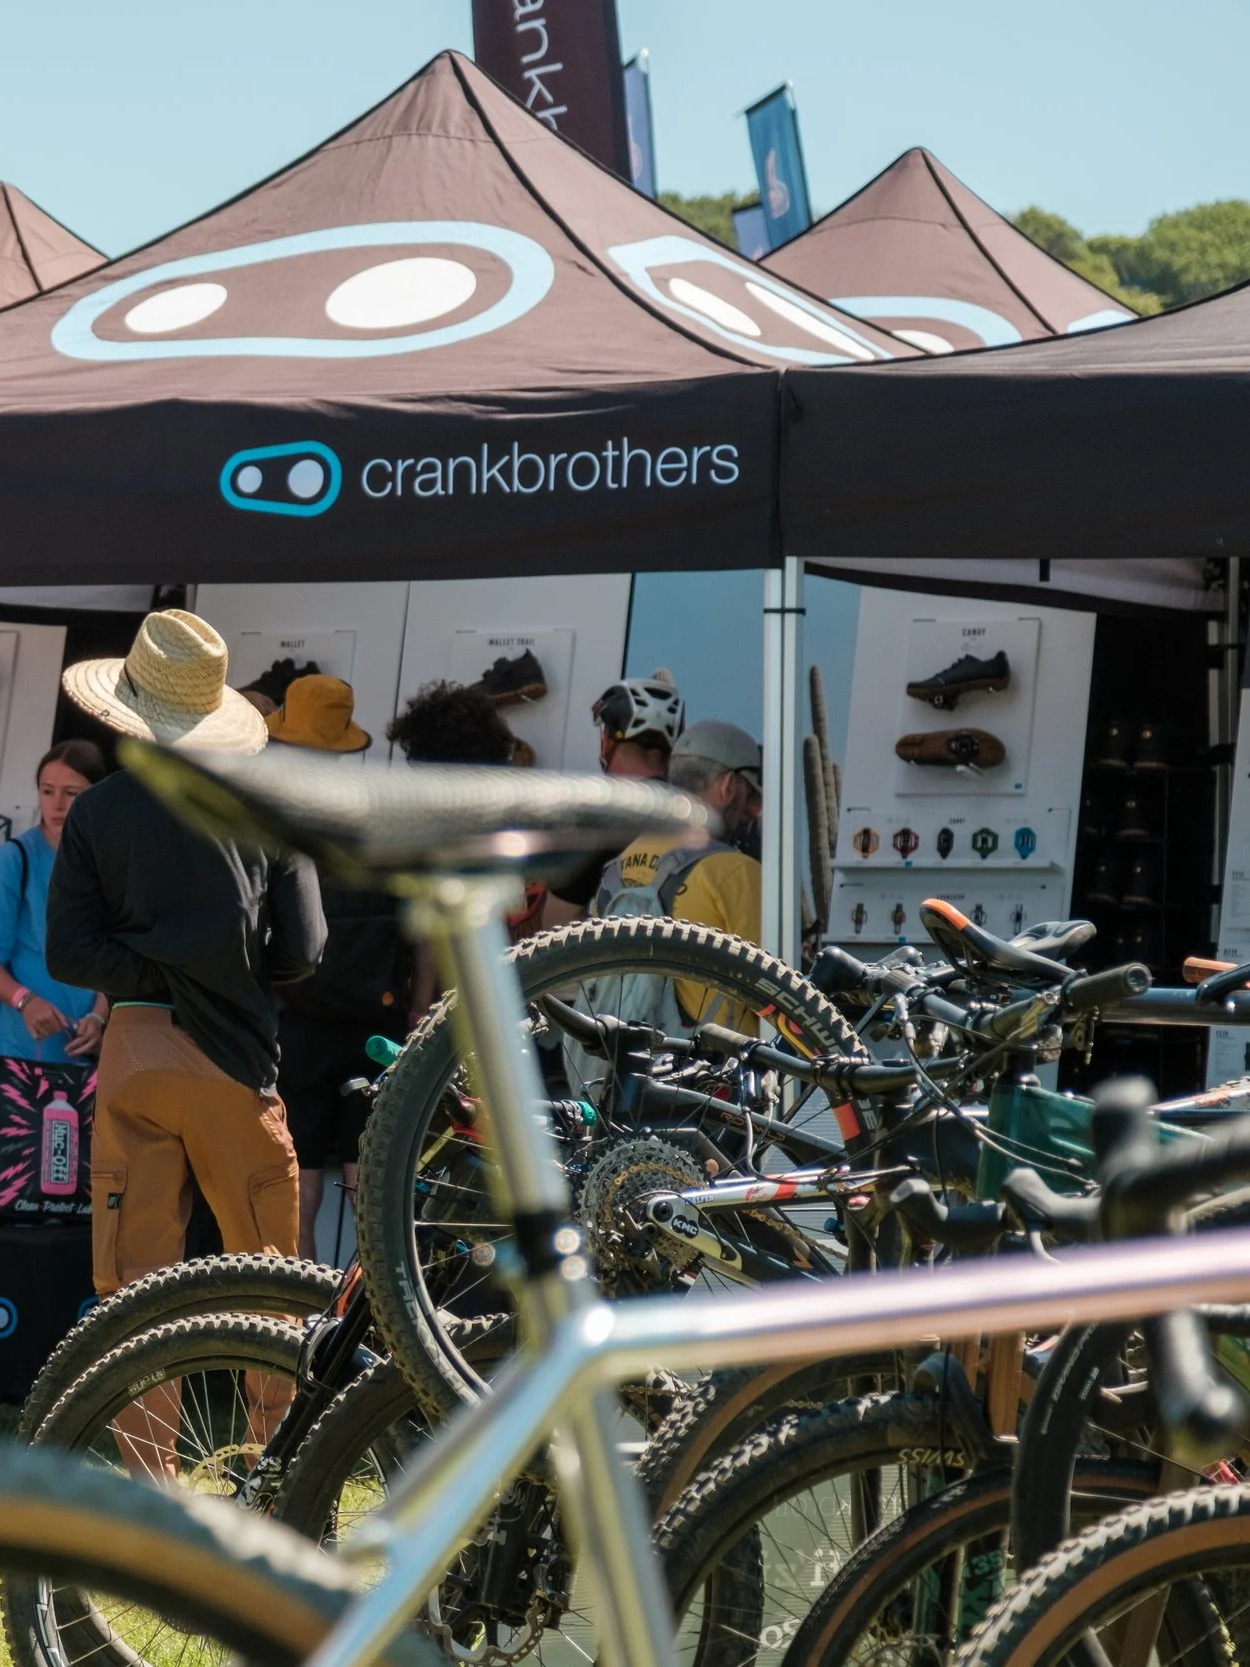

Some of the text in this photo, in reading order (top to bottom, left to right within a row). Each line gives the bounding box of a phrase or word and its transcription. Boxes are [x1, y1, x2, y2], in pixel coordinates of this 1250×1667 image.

[362, 437, 740, 498] crankbrothers
[53, 1123, 68, 1182] Muc-Off
[673, 1218, 698, 1235] KMC
[896, 1448, 966, 1467] SWISS
